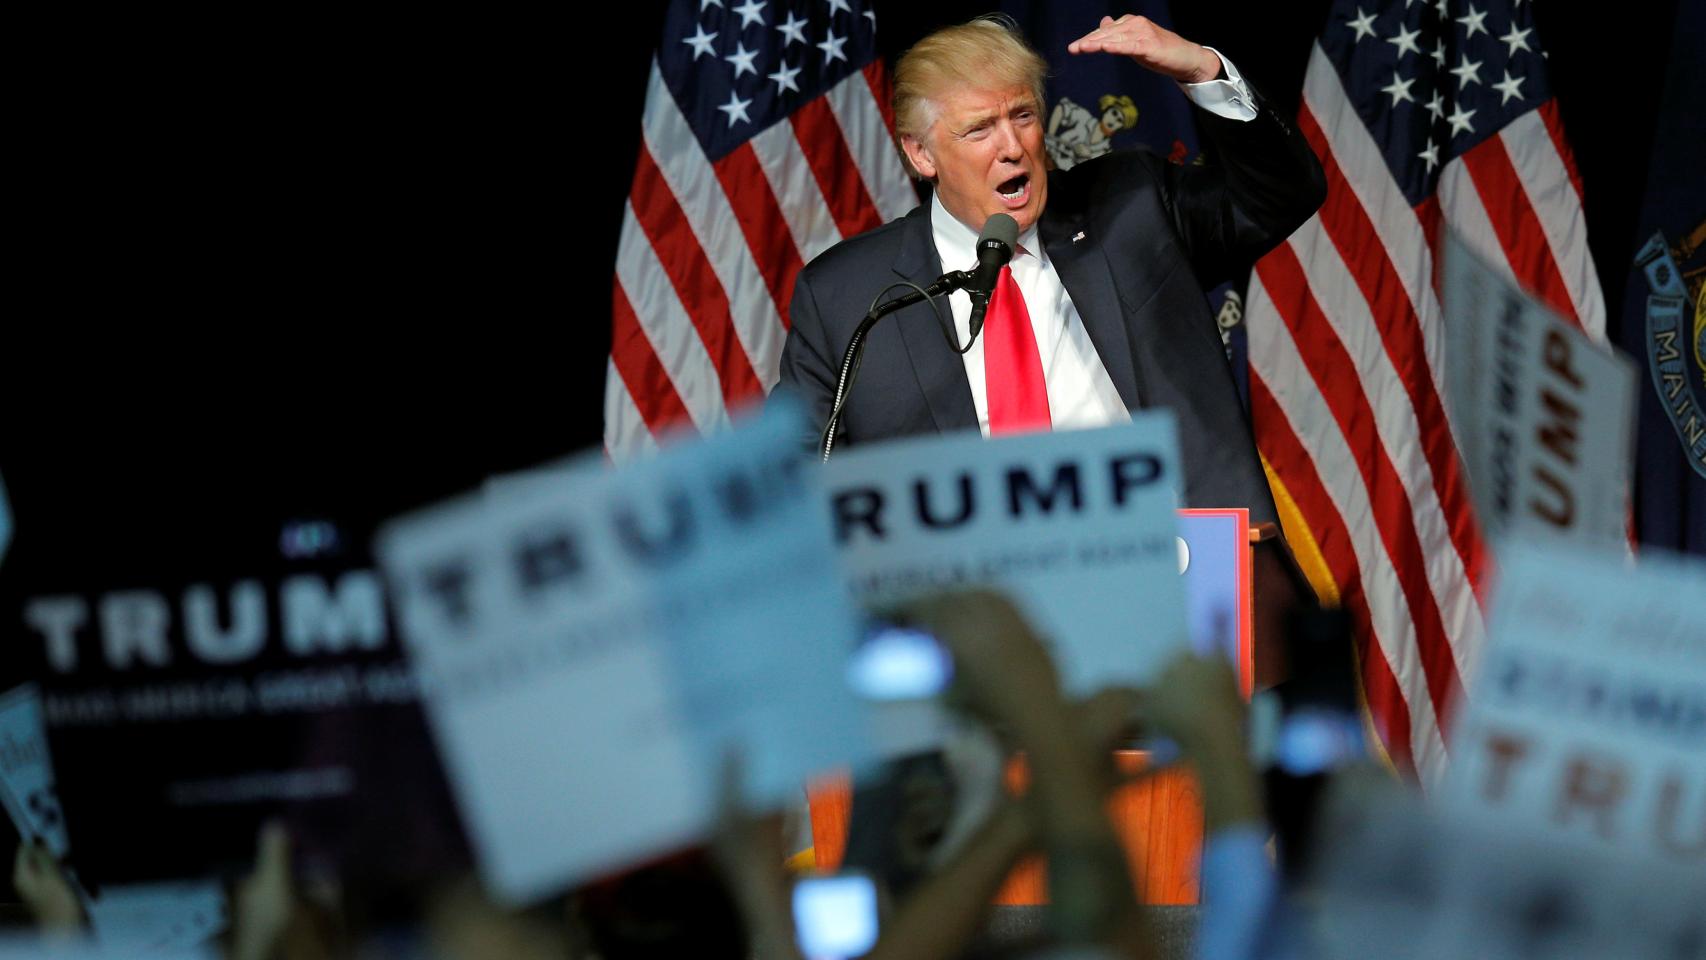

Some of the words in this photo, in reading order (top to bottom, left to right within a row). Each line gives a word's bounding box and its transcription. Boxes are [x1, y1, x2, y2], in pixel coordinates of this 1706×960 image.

[1529, 327, 1588, 530] UMP
[1654, 330, 1706, 466] MAIN
[420, 452, 808, 632] TRU
[831, 451, 1166, 546] RUMP
[25, 570, 388, 672] TRUM
[1483, 727, 1706, 864] TRU
